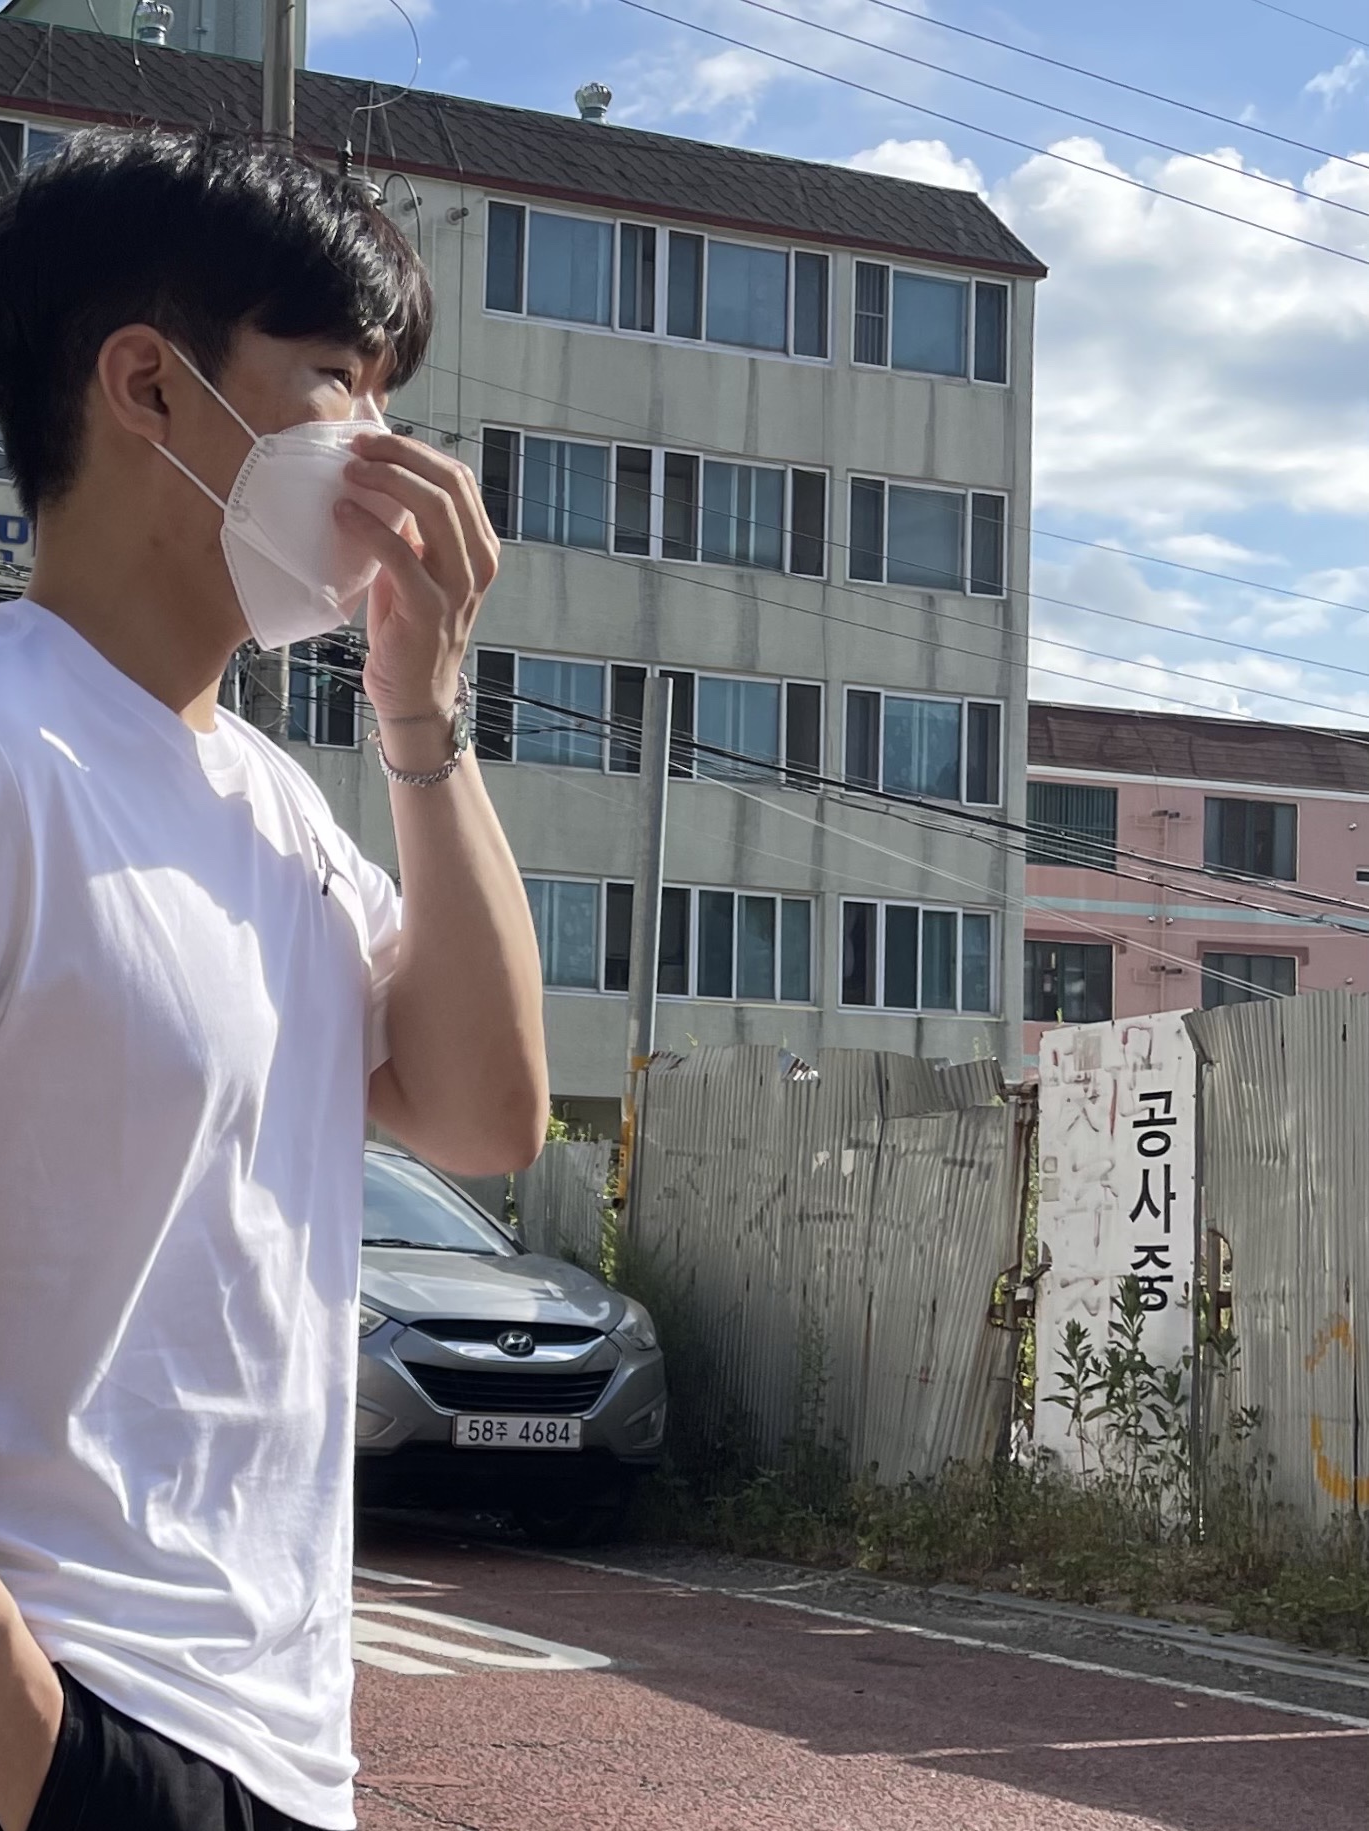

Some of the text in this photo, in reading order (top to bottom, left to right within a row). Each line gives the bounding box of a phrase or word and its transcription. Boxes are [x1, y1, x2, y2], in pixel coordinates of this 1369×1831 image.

[1128, 1090, 1178, 1313] 공사중
[467, 1419, 570, 1444] 58주 4684
